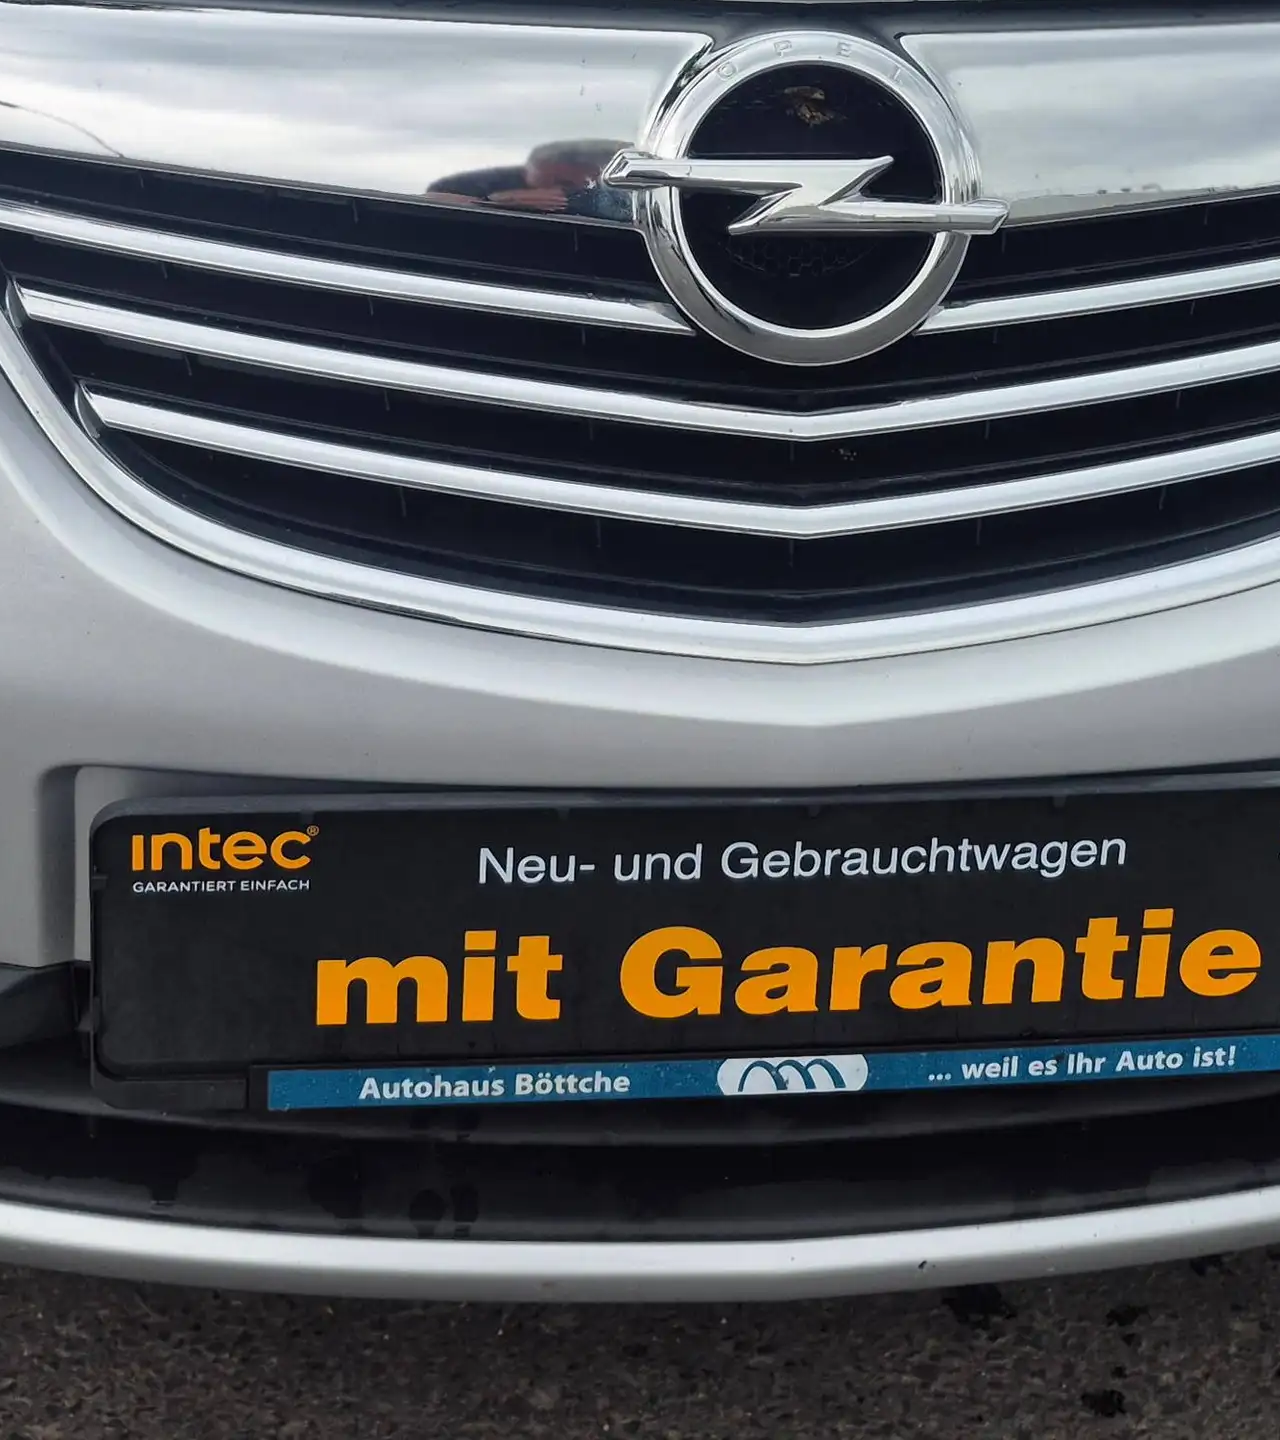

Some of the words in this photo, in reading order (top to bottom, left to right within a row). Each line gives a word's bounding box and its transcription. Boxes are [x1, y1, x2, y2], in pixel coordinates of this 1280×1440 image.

[718, 39, 902, 86] OPEL
[477, 846, 596, 885] Neu-
[613, 842, 704, 882] und
[720, 836, 1128, 880] Gebrauchtwagen
[132, 879, 238, 894] GARANTIERT
[240, 878, 311, 892] EINFACH
[315, 930, 564, 1026] mit
[619, 906, 1262, 1020] Garantie
[960, 1055, 1019, 1080] weil
[1027, 1058, 1058, 1078] es
[1066, 1051, 1106, 1075] Ihr
[1114, 1049, 1184, 1073] Auto
[1192, 1044, 1237, 1068] ist!
[358, 1073, 506, 1100] Autohaus
[514, 1071, 632, 1096] Böttche
